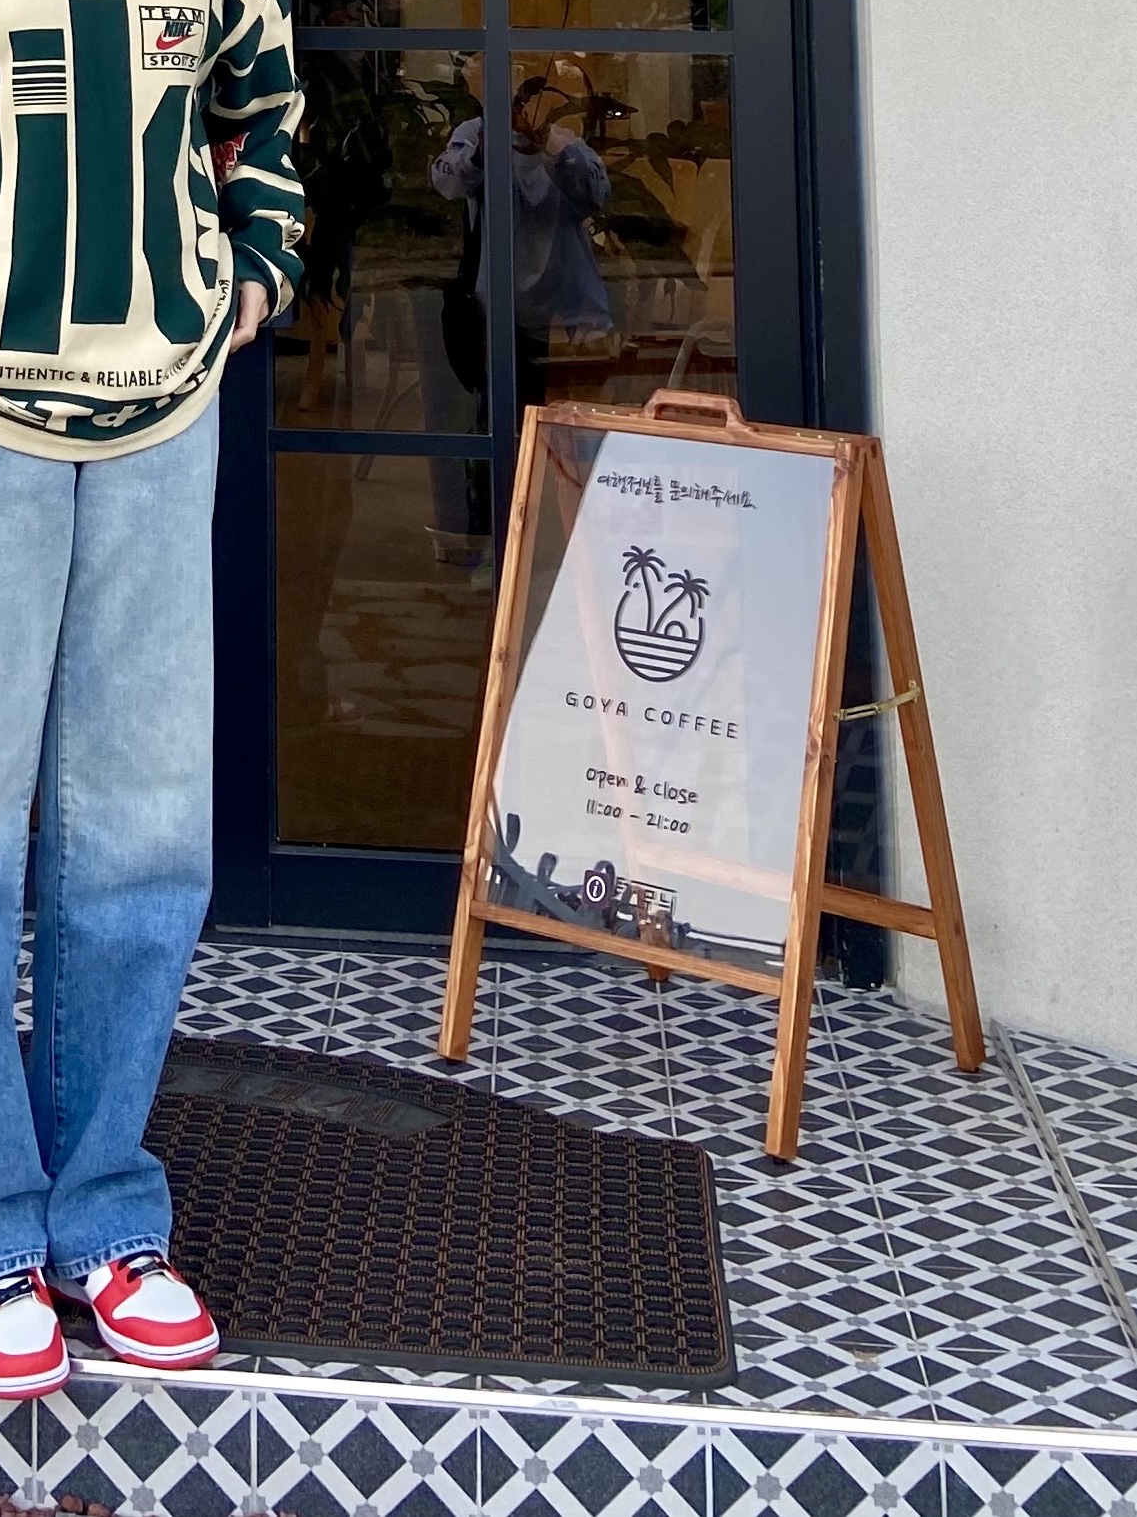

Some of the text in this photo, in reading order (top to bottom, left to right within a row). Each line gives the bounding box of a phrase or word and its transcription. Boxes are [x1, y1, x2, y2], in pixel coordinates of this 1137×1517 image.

[144, 7, 203, 23] TEAM
[163, 21, 194, 38] NIKE
[80, 371, 91, 383] &
[96, 368, 163, 388] RELIABLE
[597, 471, 664, 503] 여행정보를
[565, 691, 739, 739] GOYA COFFEE
[634, 774, 648, 795] &
[653, 781, 699, 804] close
[586, 798, 623, 819] 11:00
[646, 812, 691, 834] 21:00
